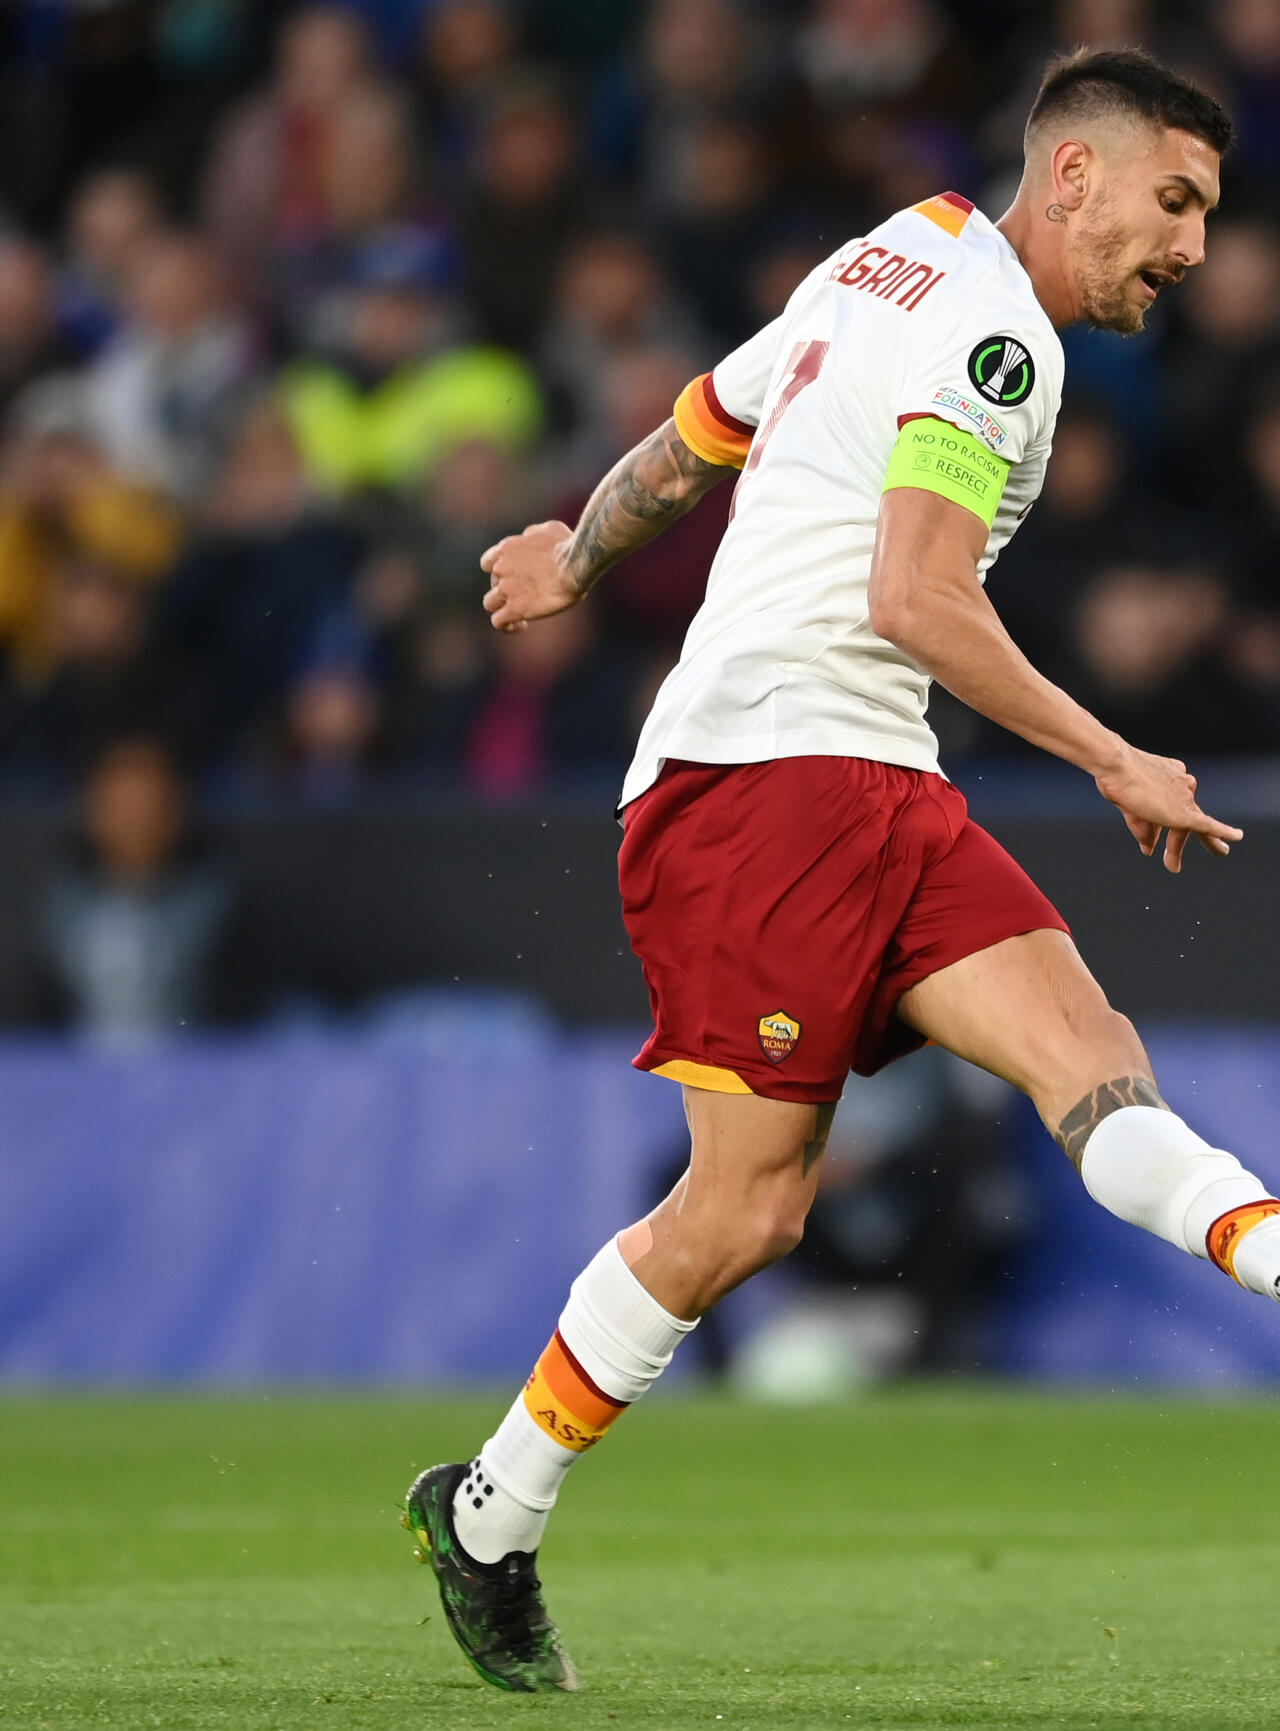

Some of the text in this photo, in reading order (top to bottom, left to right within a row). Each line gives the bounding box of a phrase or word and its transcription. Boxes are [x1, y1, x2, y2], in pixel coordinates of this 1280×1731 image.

[933, 392, 1006, 445] FOUNDATION
[913, 433, 1000, 479] NO TO RACISM
[936, 459, 988, 495] RESPECT
[763, 1039, 791, 1051] ROMA
